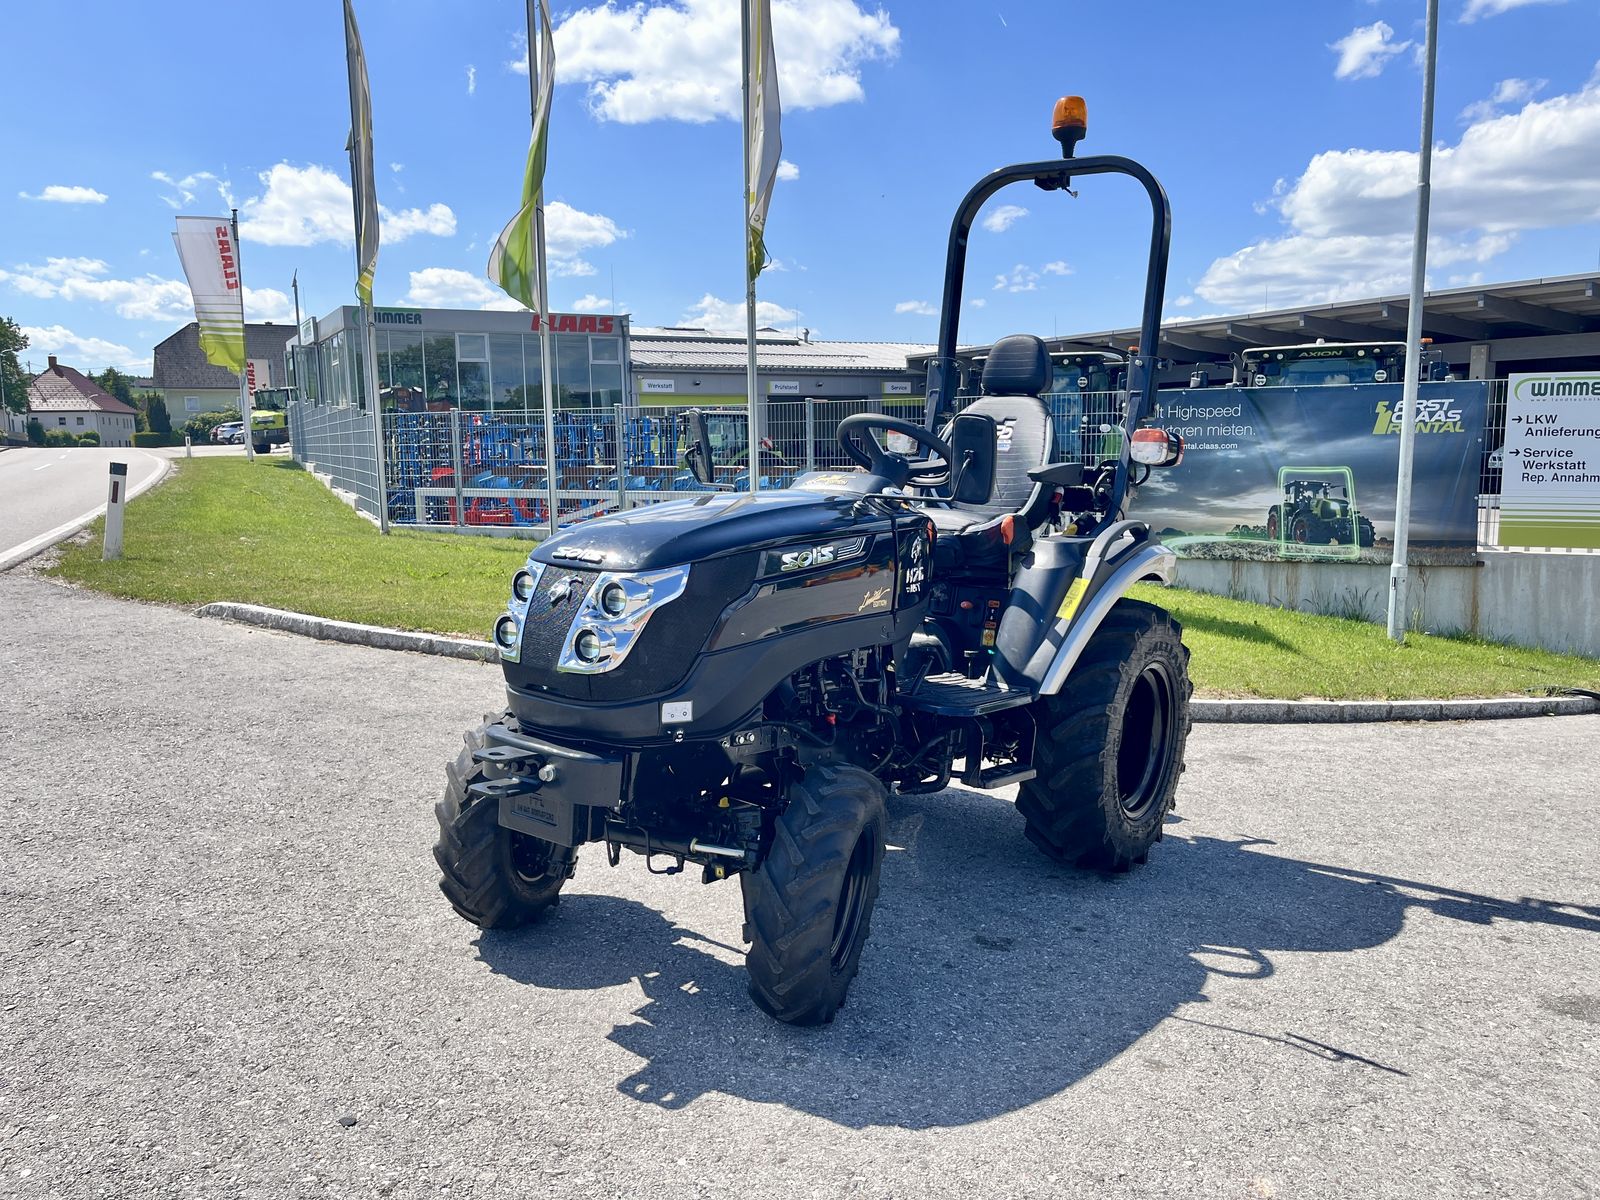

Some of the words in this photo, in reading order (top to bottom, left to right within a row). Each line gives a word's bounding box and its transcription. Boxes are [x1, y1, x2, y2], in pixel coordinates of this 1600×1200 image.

[374, 312, 422, 324] IMMER
[1298, 350, 1343, 358] AXION
[647, 382, 673, 390] Werkstatt
[1530, 382, 1600, 397] WIMME
[1394, 398, 1455, 413] FRST
[1167, 403, 1242, 421] Highspeed
[1526, 414, 1558, 424] LKW
[1206, 423, 1256, 436] mieten.
[1525, 427, 1600, 439] Anlieferung
[1523, 447, 1573, 457] Service
[1523, 460, 1586, 470] Werkstatt
[1521, 473, 1547, 484] Rep.
[1551, 473, 1600, 482] Annahm
